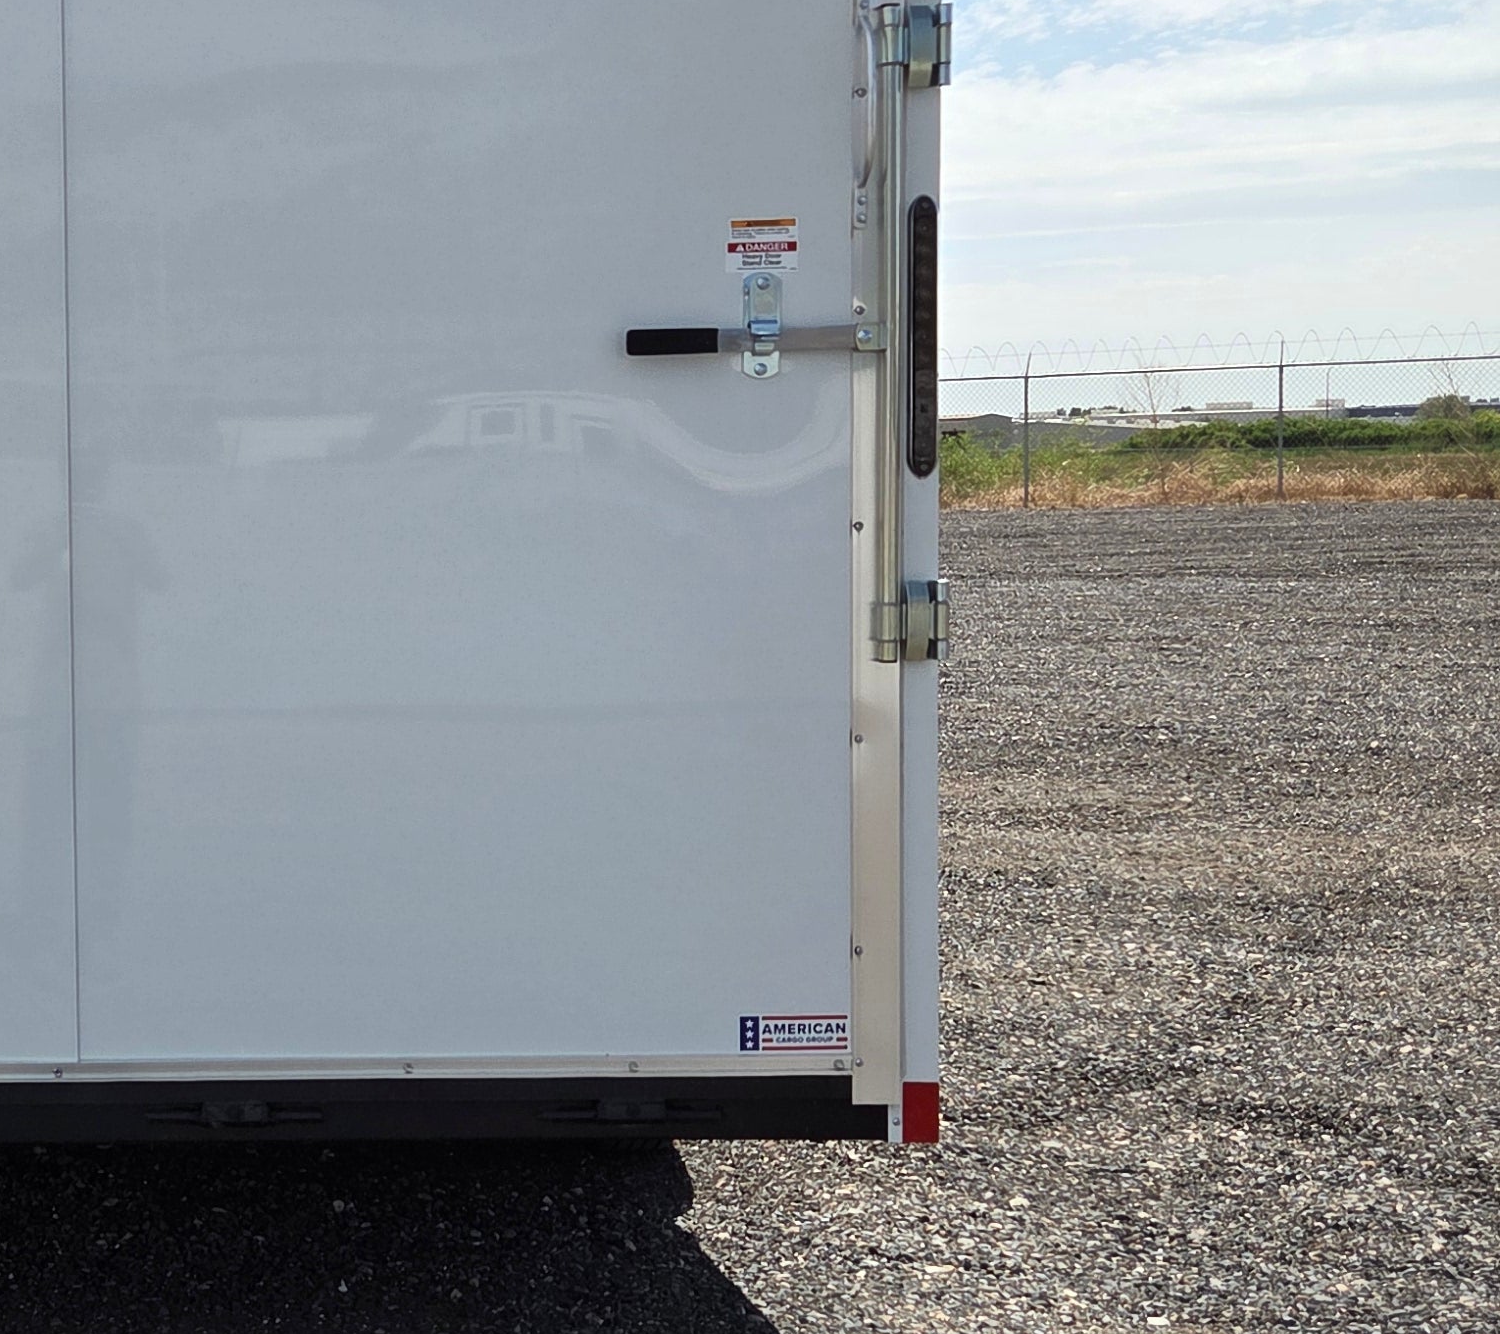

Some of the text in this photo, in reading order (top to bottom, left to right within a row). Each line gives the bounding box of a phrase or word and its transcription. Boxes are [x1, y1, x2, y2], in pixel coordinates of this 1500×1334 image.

[745, 242, 789, 252] DANGER
[762, 1022, 846, 1035] AMERICAN
[805, 1035, 834, 1043] GROUP
